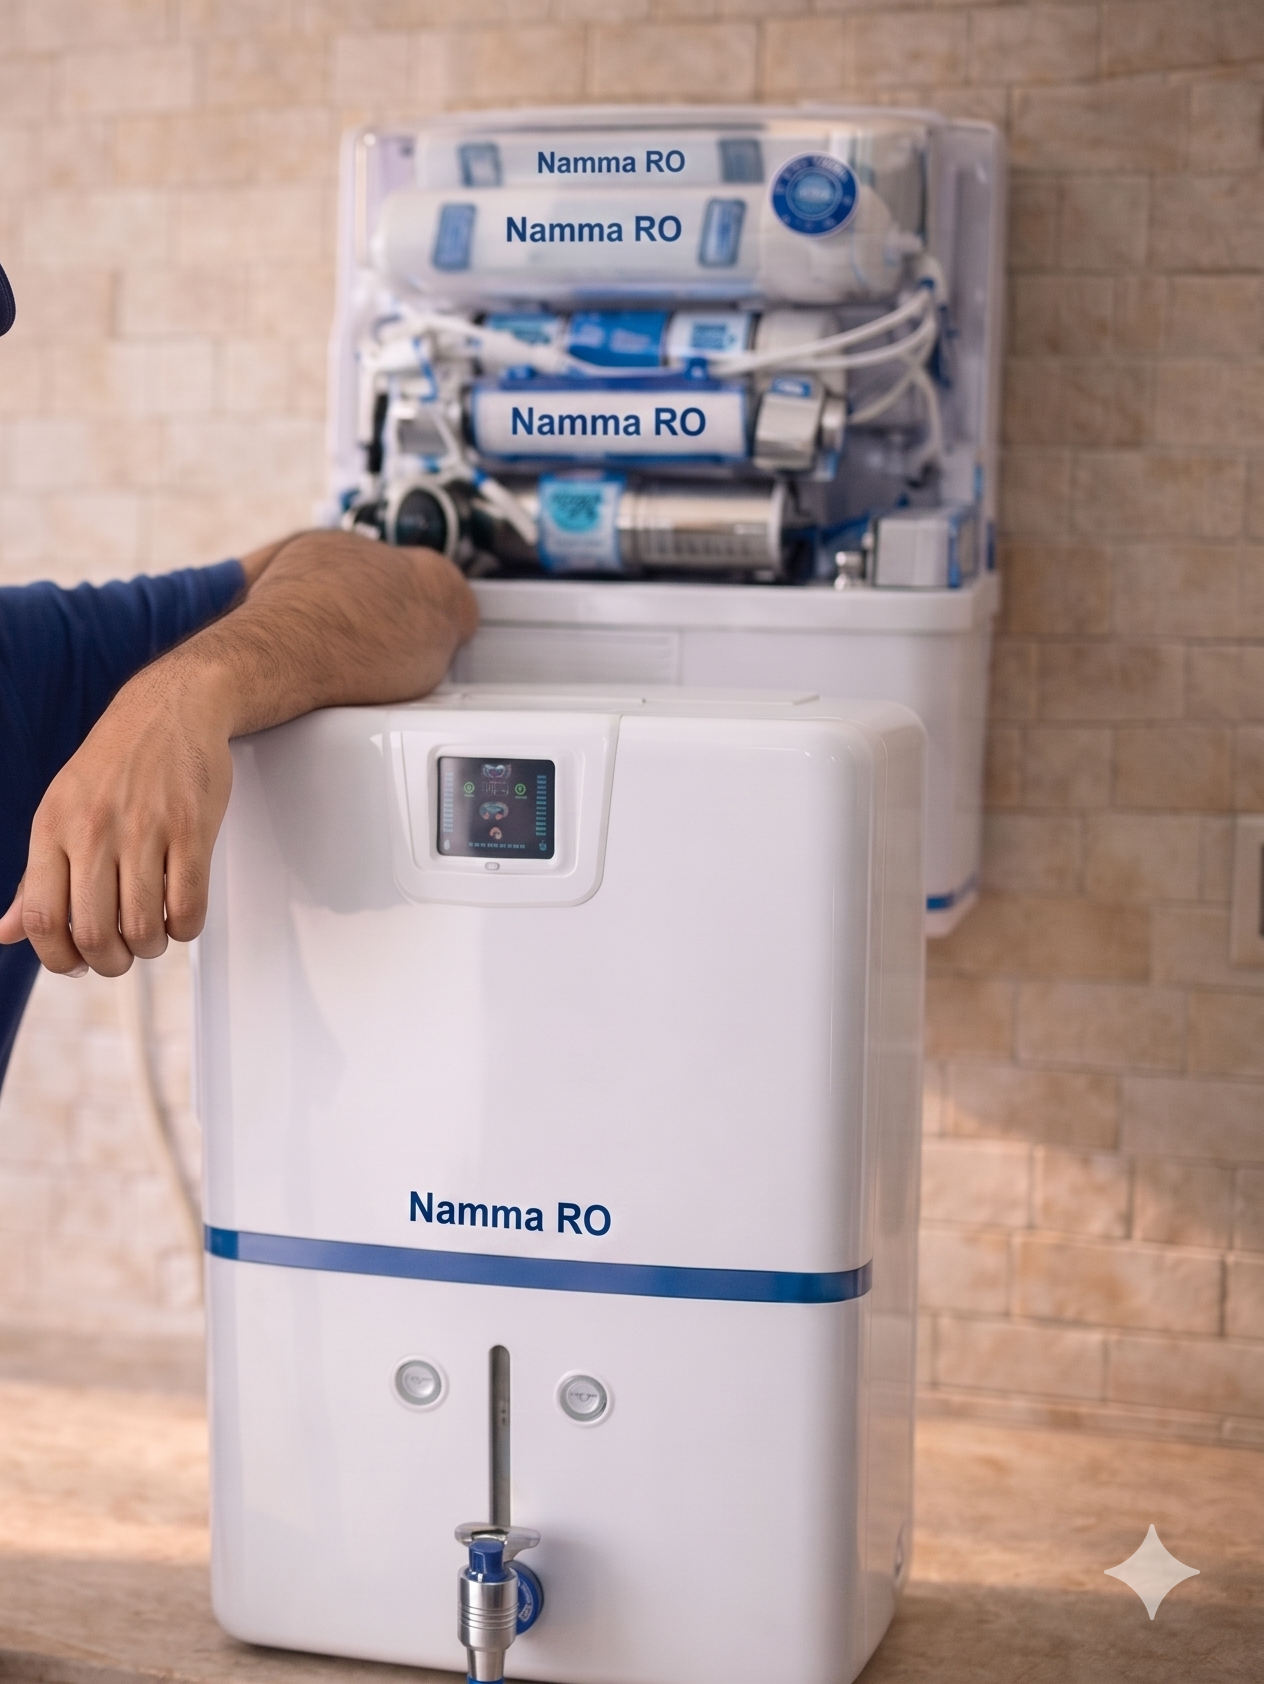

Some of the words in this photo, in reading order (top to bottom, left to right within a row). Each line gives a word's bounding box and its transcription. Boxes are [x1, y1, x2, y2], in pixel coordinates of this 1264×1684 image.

[537, 150, 637, 174] Namma
[646, 149, 686, 173] RO
[506, 216, 623, 243] Namma
[635, 215, 682, 243] RO
[511, 406, 641, 437] Namma
[654, 407, 706, 437] RO
[409, 1190, 544, 1232] Namma
[557, 1202, 612, 1237] RO
